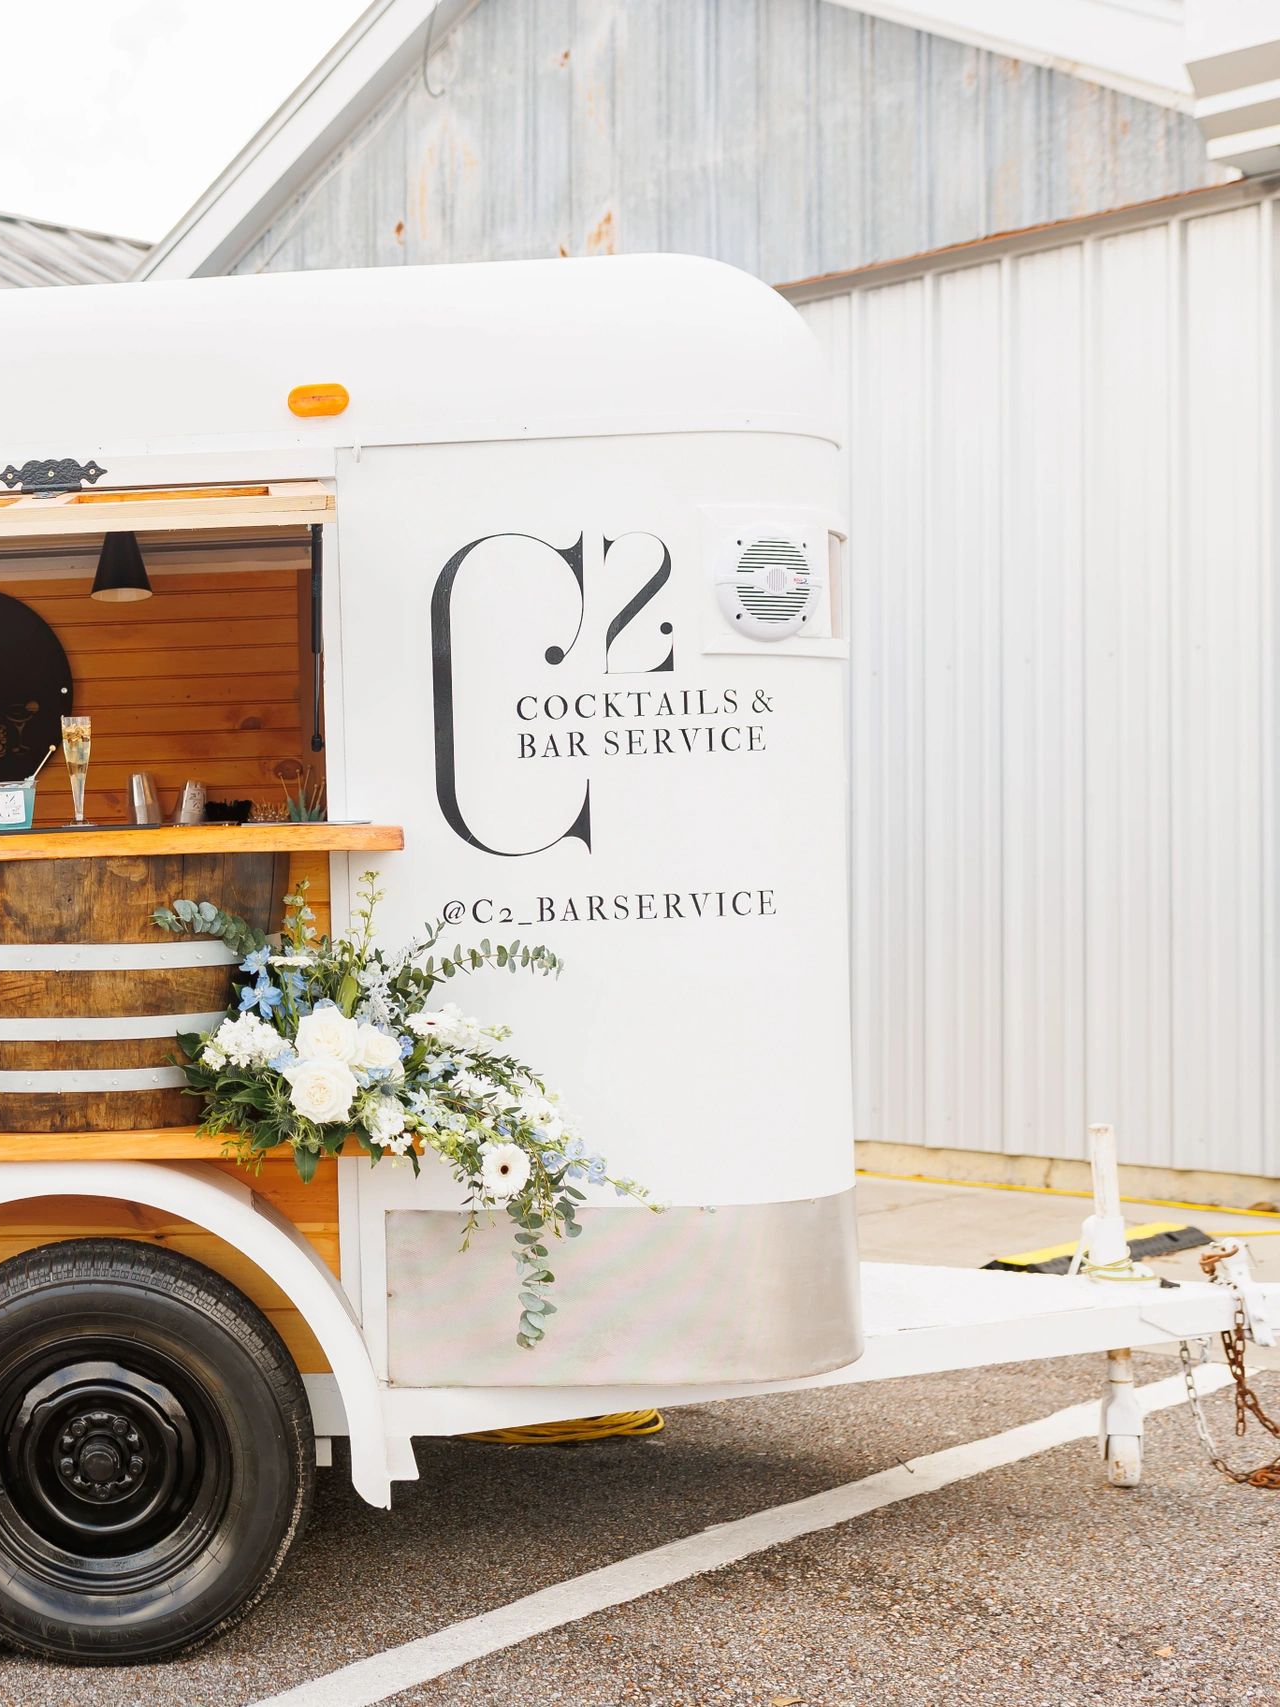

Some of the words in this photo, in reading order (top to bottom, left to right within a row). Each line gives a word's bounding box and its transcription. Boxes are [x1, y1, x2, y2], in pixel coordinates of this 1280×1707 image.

[516, 689, 738, 721] COCKTAILS
[751, 689, 774, 714] &
[517, 731, 590, 759] BAR
[603, 725, 767, 756] SERVICE
[442, 889, 777, 925] @C2_BARSERVICE
